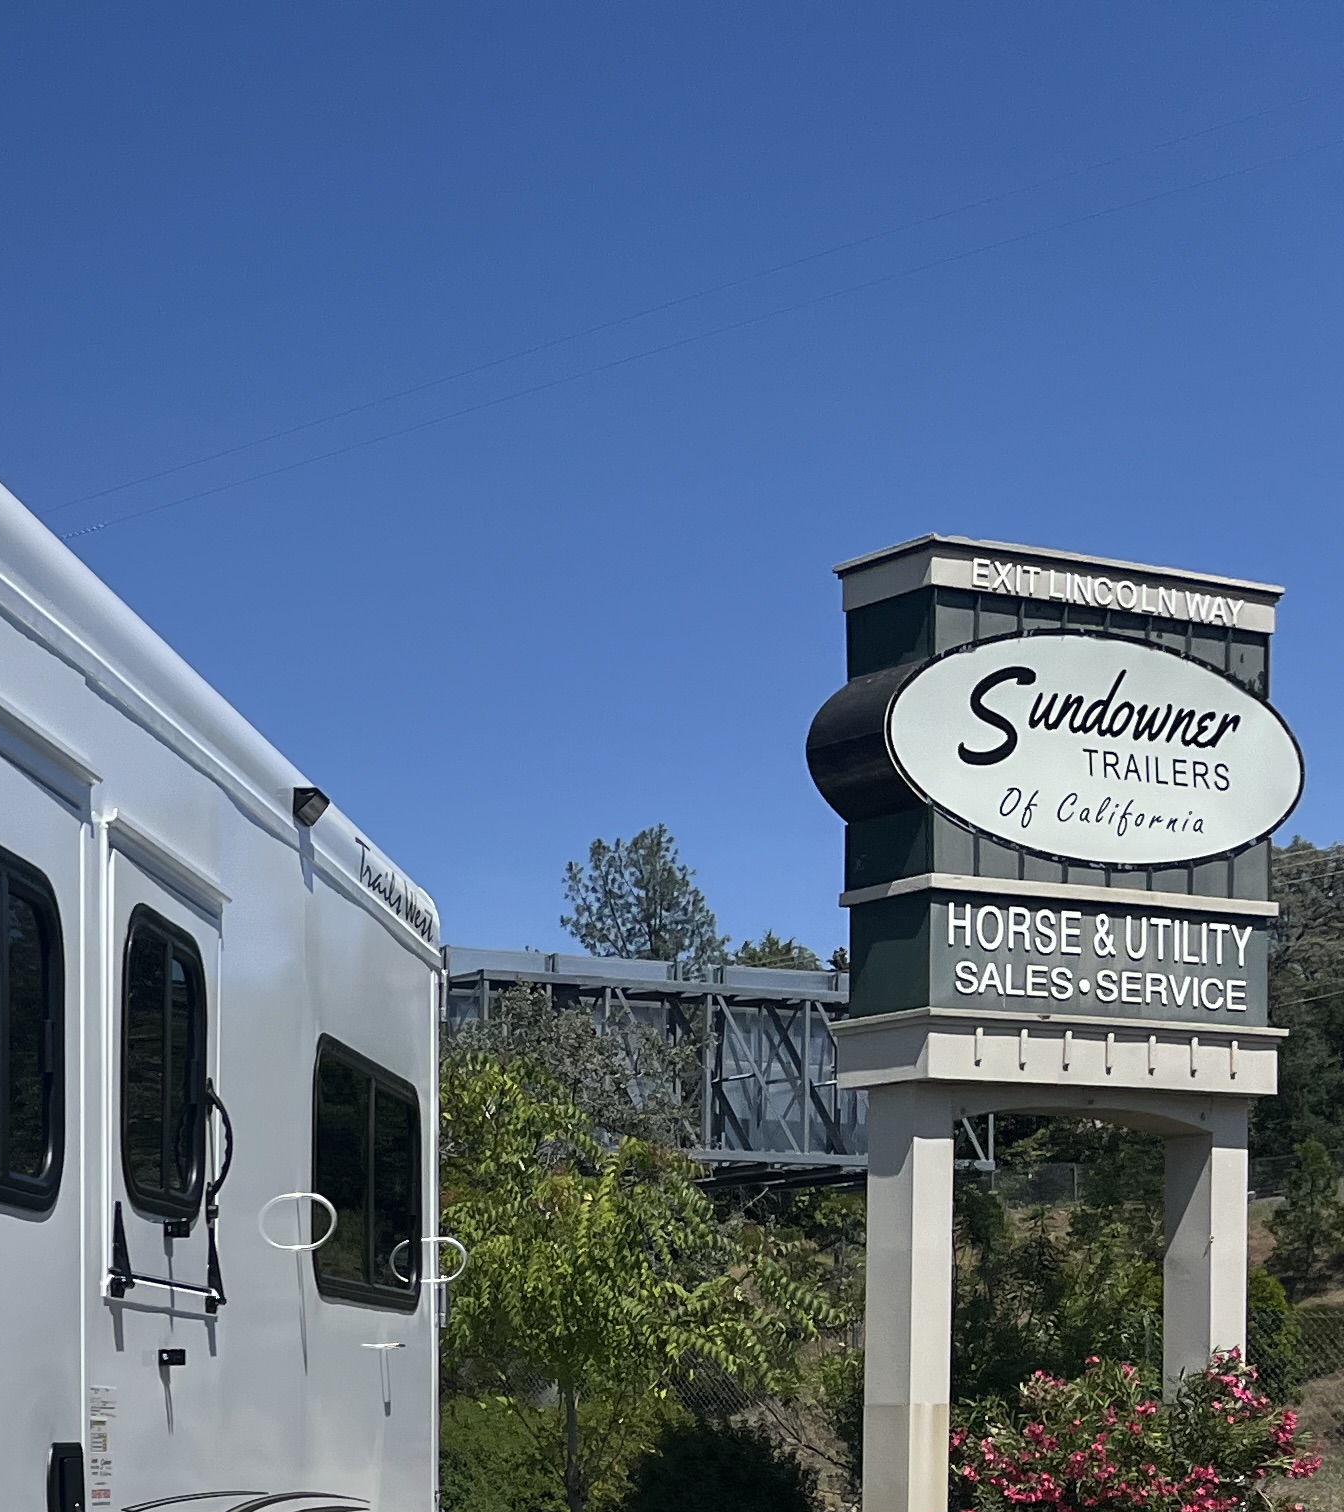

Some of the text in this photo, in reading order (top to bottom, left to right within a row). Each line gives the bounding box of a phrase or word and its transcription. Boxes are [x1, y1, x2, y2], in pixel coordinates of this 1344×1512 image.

[971, 557, 1244, 627] EXIT LINCOLN WAY
[957, 666, 1241, 766] Sundowner
[1082, 748, 1231, 792] TRAILERS
[999, 786, 1206, 837] Of California
[354, 836, 402, 915] Trails
[947, 901, 1253, 968] HORSE & UTILITY
[954, 960, 1248, 1012] SALES SERVICE
